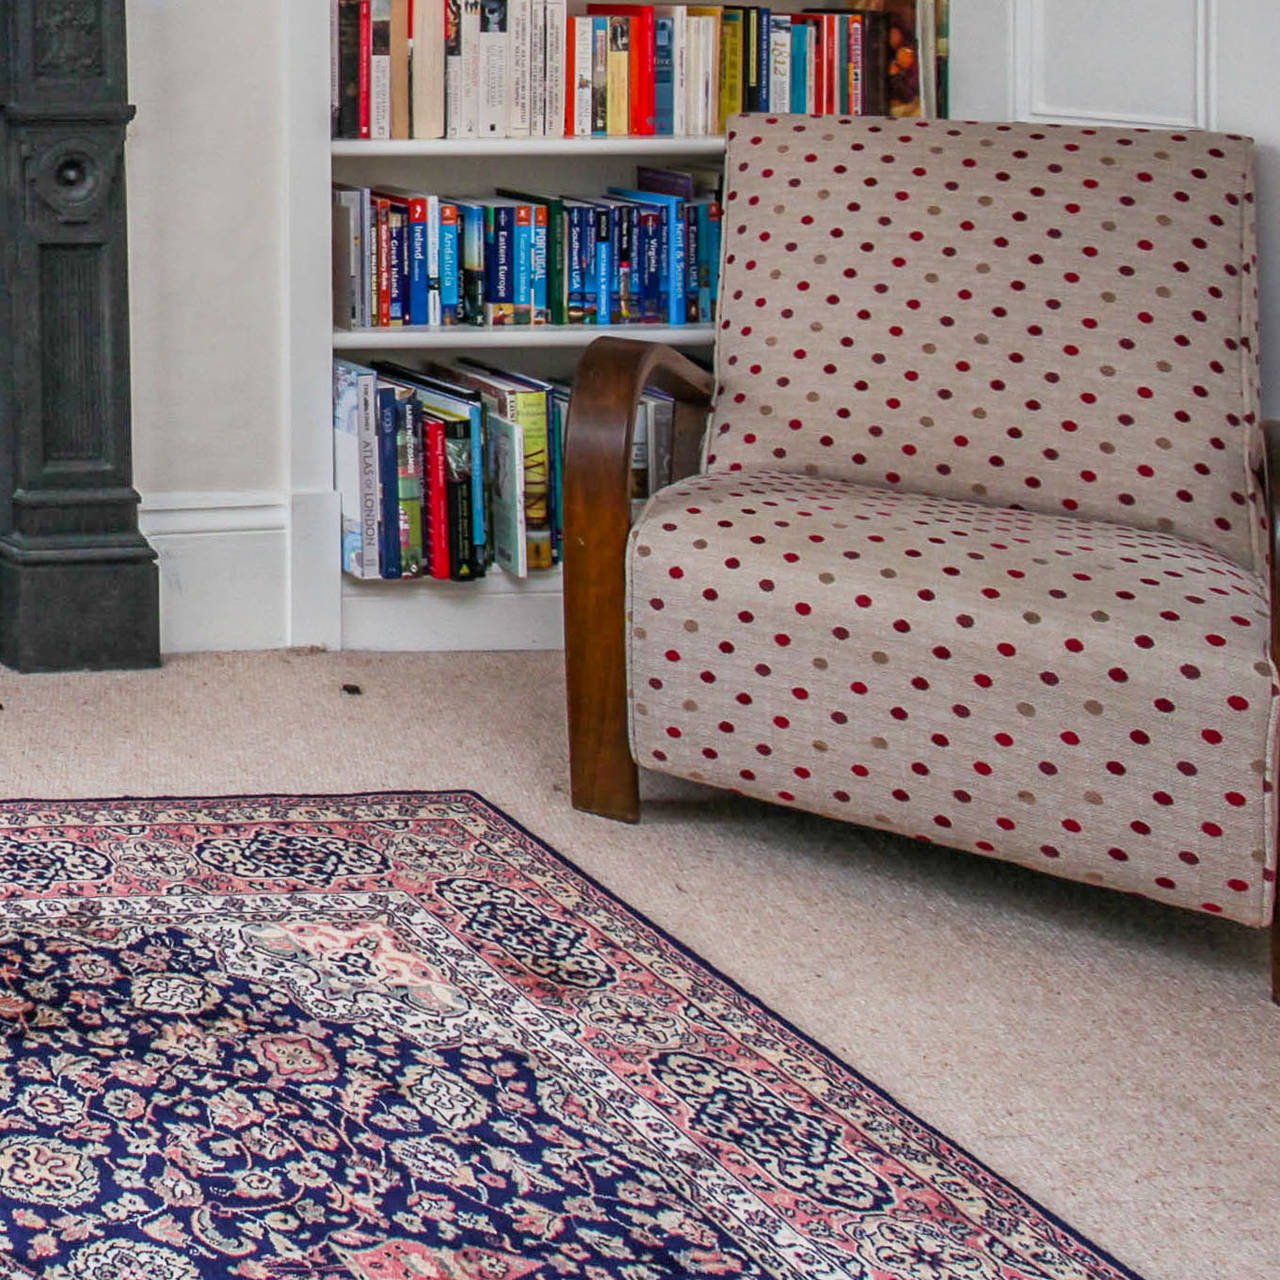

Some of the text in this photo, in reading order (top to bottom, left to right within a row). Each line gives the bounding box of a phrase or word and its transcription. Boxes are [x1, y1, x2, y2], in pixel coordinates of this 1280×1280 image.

[771, 40, 789, 78] 1812
[391, 239, 399, 298] Greek Islands
[414, 226, 424, 259] Ireland
[444, 232, 454, 286] Andalucia
[498, 230, 507, 297] Eastern Europe
[535, 228, 546, 281] PORTUGAL
[571, 226, 580, 289] Southwest USA
[648, 238, 657, 272] Virginia
[675, 223, 684, 299] Kent & Sussex
[362, 440, 375, 476] ATLAS
[362, 492, 375, 546] LONDON
